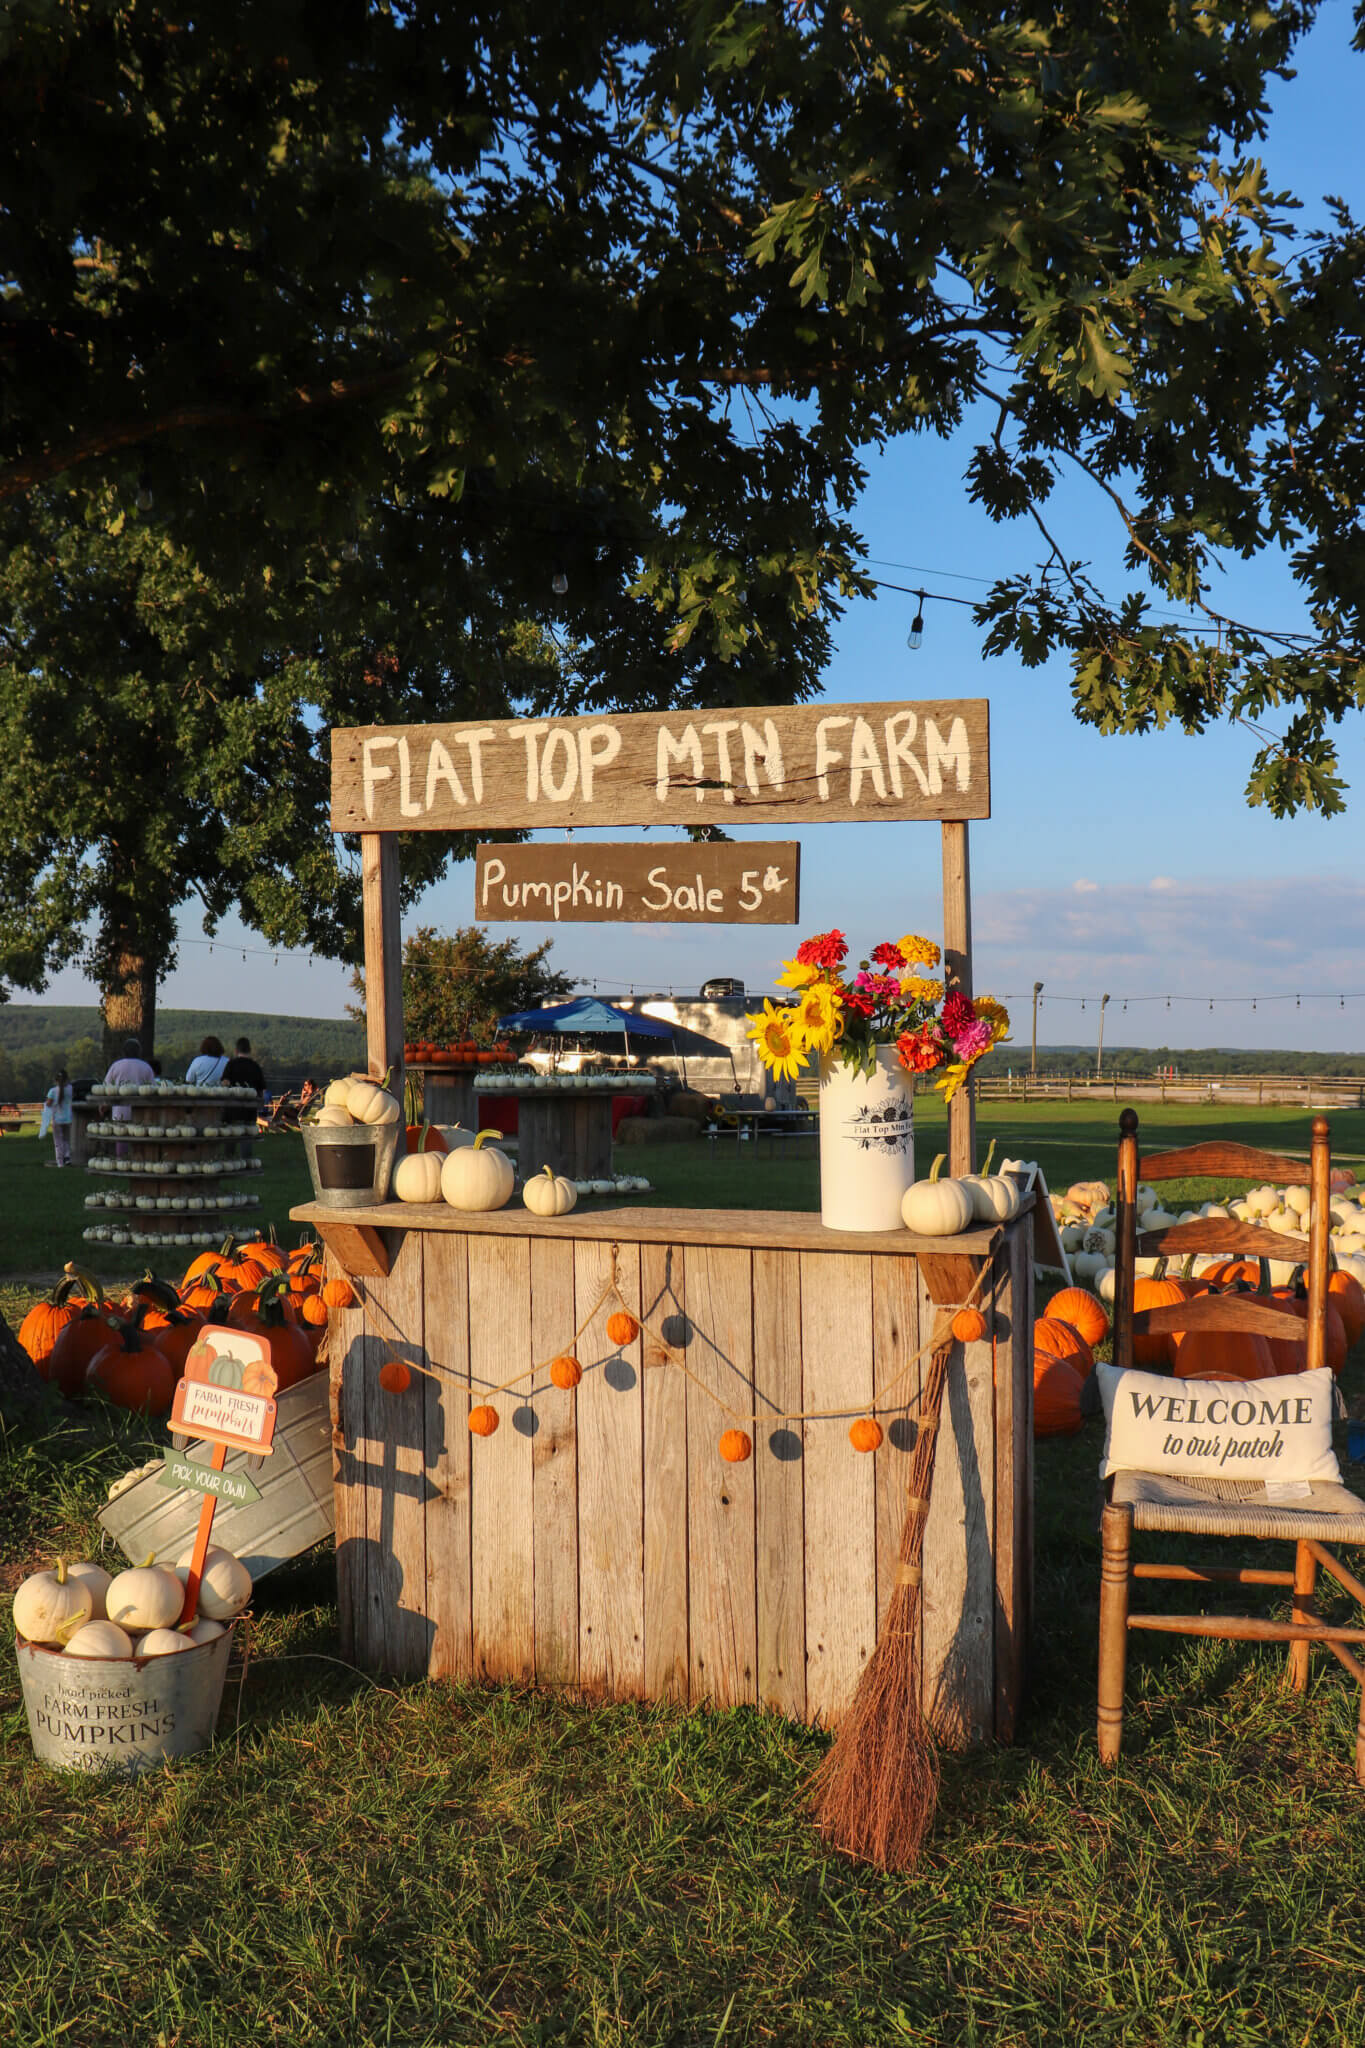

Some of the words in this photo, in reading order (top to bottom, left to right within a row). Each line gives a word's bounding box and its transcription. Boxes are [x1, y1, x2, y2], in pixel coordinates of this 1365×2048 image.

[361, 727, 494, 820] FLAT
[507, 720, 623, 804] TOP
[655, 716, 785, 804] MTN
[815, 709, 972, 806] FARM
[481, 858, 623, 921] Pumpkin
[640, 866, 724, 914] Sale
[854, 1125, 870, 1134] Flat
[872, 1125, 888, 1135] Top
[191, 1403, 254, 1435] pumpkins
[194, 1389, 222, 1405] FARM
[227, 1397, 259, 1414] FRESH
[1129, 1391, 1313, 1426] WELCOME
[1162, 1433, 1183, 1455] to
[1186, 1435, 1220, 1457] our
[1219, 1430, 1285, 1466] patch
[172, 1463, 192, 1483] PICK
[194, 1472, 221, 1493] YOUR
[222, 1479, 247, 1500] OWN
[44, 1694, 88, 1720] FARM
[95, 1700, 159, 1720] FRESH
[58, 1684, 86, 1699] hand
[89, 1688, 131, 1701] picked
[36, 1709, 177, 1745] PUMPKINS
